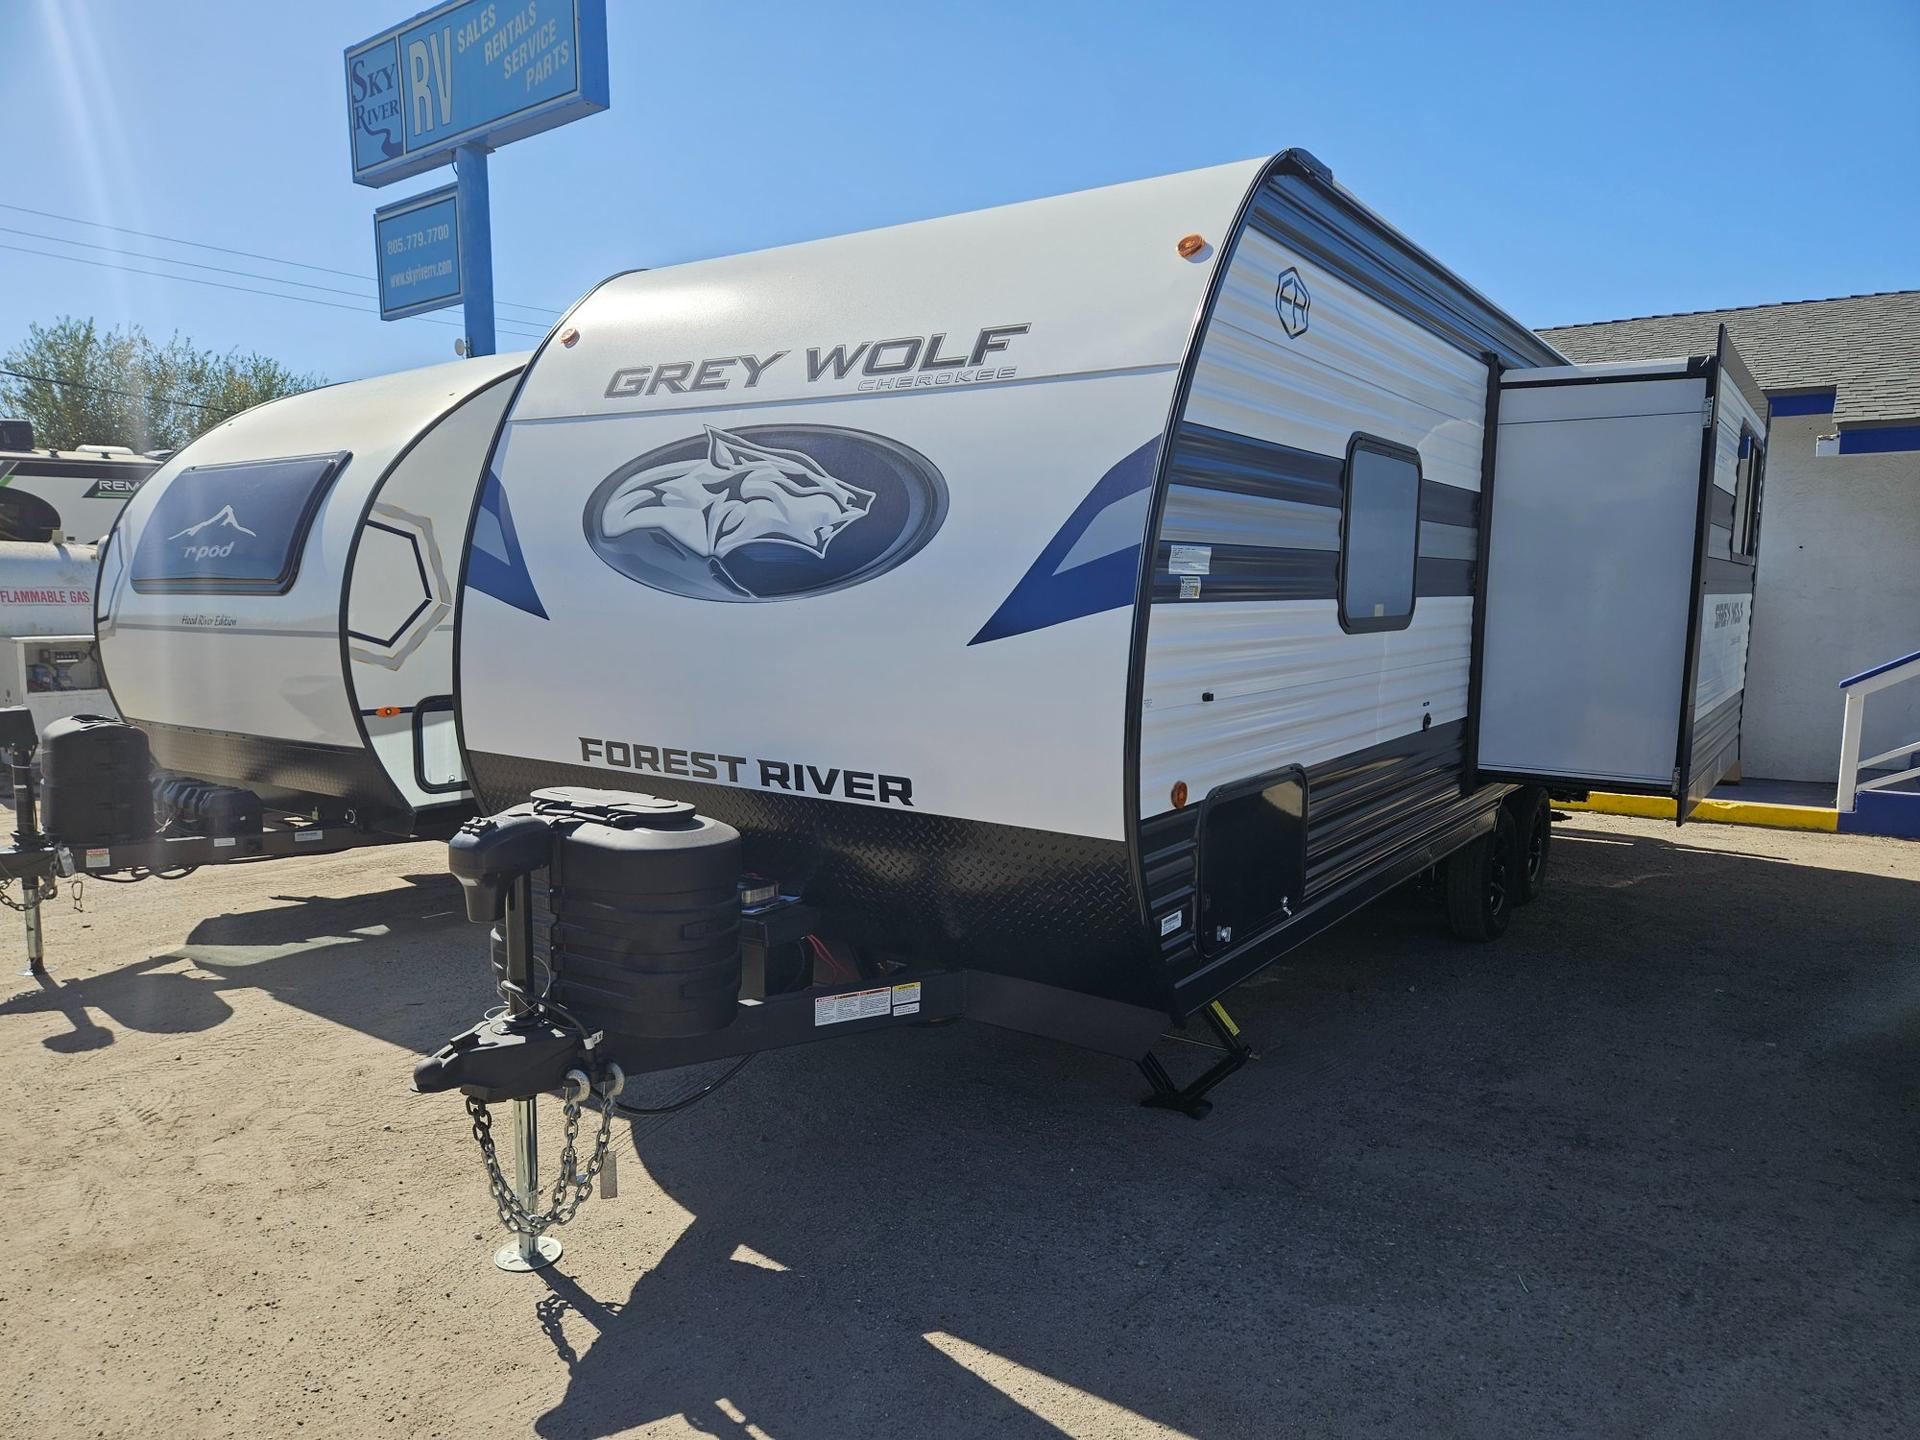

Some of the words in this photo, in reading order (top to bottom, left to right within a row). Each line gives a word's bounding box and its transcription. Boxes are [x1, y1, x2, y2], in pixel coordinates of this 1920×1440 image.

[457, 3, 496, 54] SALES
[484, 1, 537, 66] RENTALS
[503, 18, 557, 79] SERVICE
[408, 26, 452, 137] RV
[526, 39, 569, 92] PARTS
[604, 350, 791, 399] GREY
[806, 322, 1032, 383] WOLF
[857, 366, 1018, 392] CHEROKEE
[0, 590, 67, 604] FLAMMABLE
[69, 590, 91, 604] GAS
[578, 736, 747, 783] FOREST
[757, 759, 914, 806] RIVER
